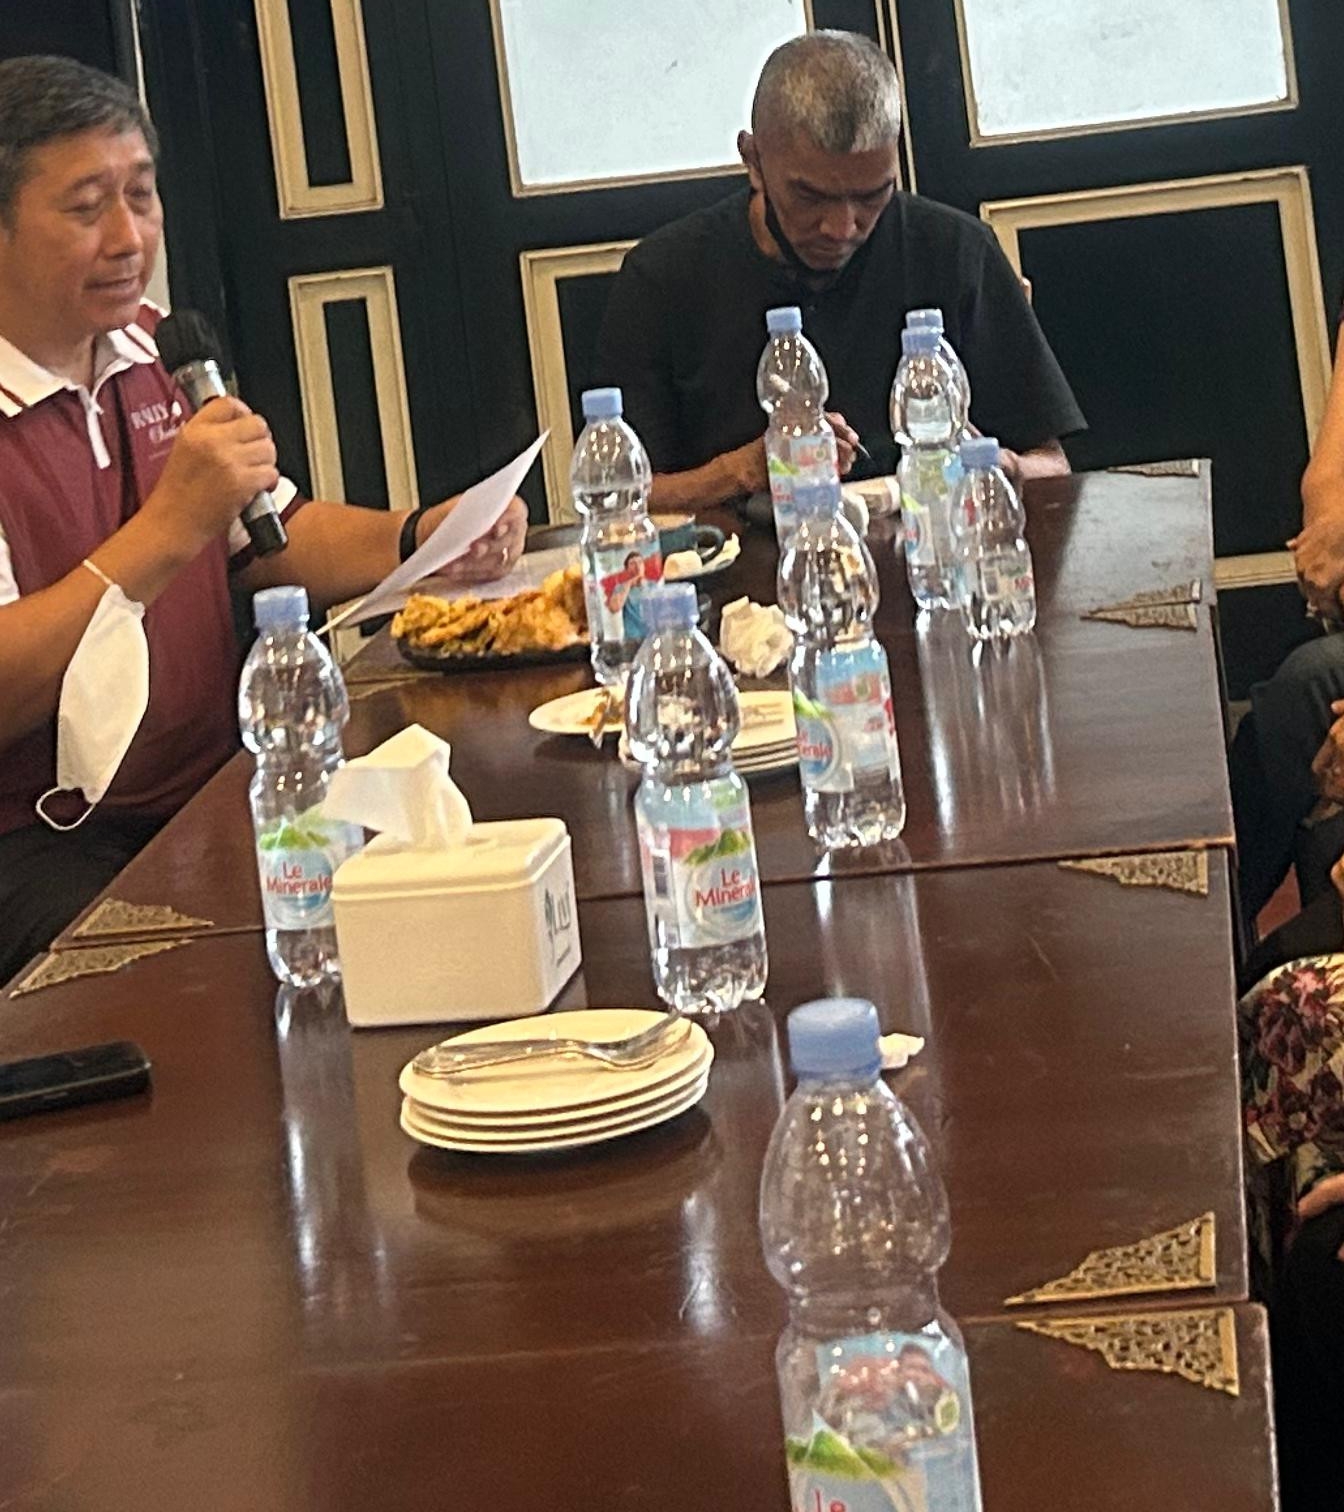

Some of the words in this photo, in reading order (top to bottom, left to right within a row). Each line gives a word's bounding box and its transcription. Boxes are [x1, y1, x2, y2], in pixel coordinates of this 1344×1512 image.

[282, 861, 302, 878] Le
[721, 868, 741, 887] Le
[266, 873, 333, 894] Minerale
